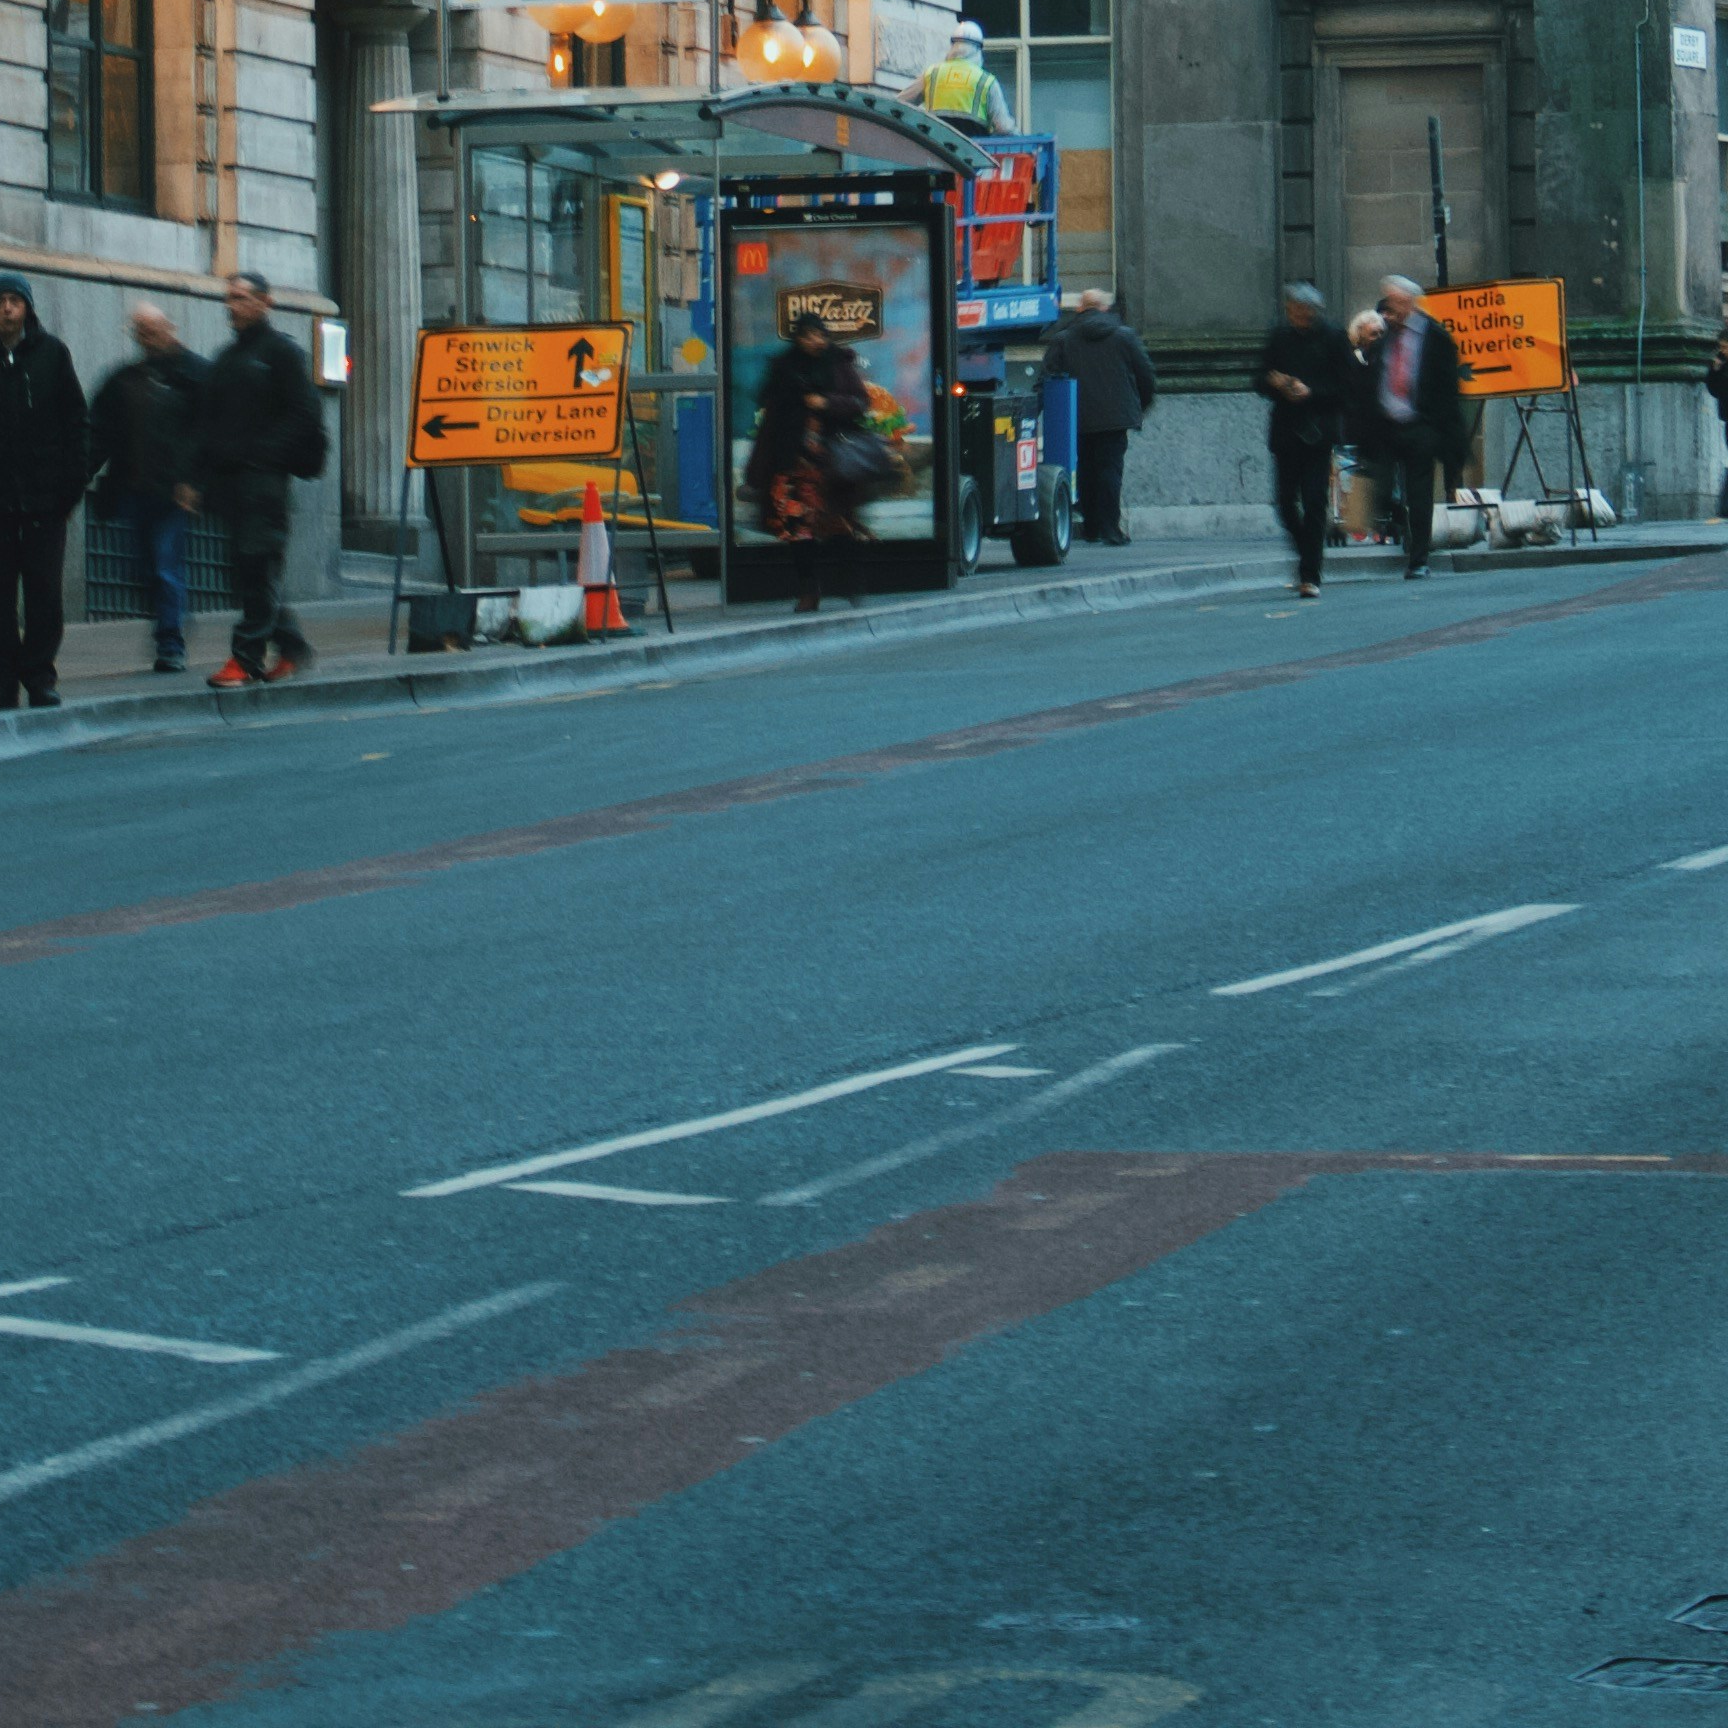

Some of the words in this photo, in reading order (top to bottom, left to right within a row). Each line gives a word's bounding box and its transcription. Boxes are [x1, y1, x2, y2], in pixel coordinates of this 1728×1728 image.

[1680, 33, 1699, 47] DERBY
[1676, 49, 1700, 63] SQUARE
[787, 294, 821, 322] BIG
[818, 293, 876, 326] Tasty
[1457, 291, 1506, 310] India
[1442, 312, 1524, 334] Bulding
[446, 336, 535, 354] Fenwick
[1459, 334, 1536, 356] liveries
[456, 356, 525, 374] Street
[437, 375, 538, 393] Diversion
[487, 406, 547, 423] Drury
[556, 404, 608, 420] Lane
[495, 426, 596, 444] Diversion
